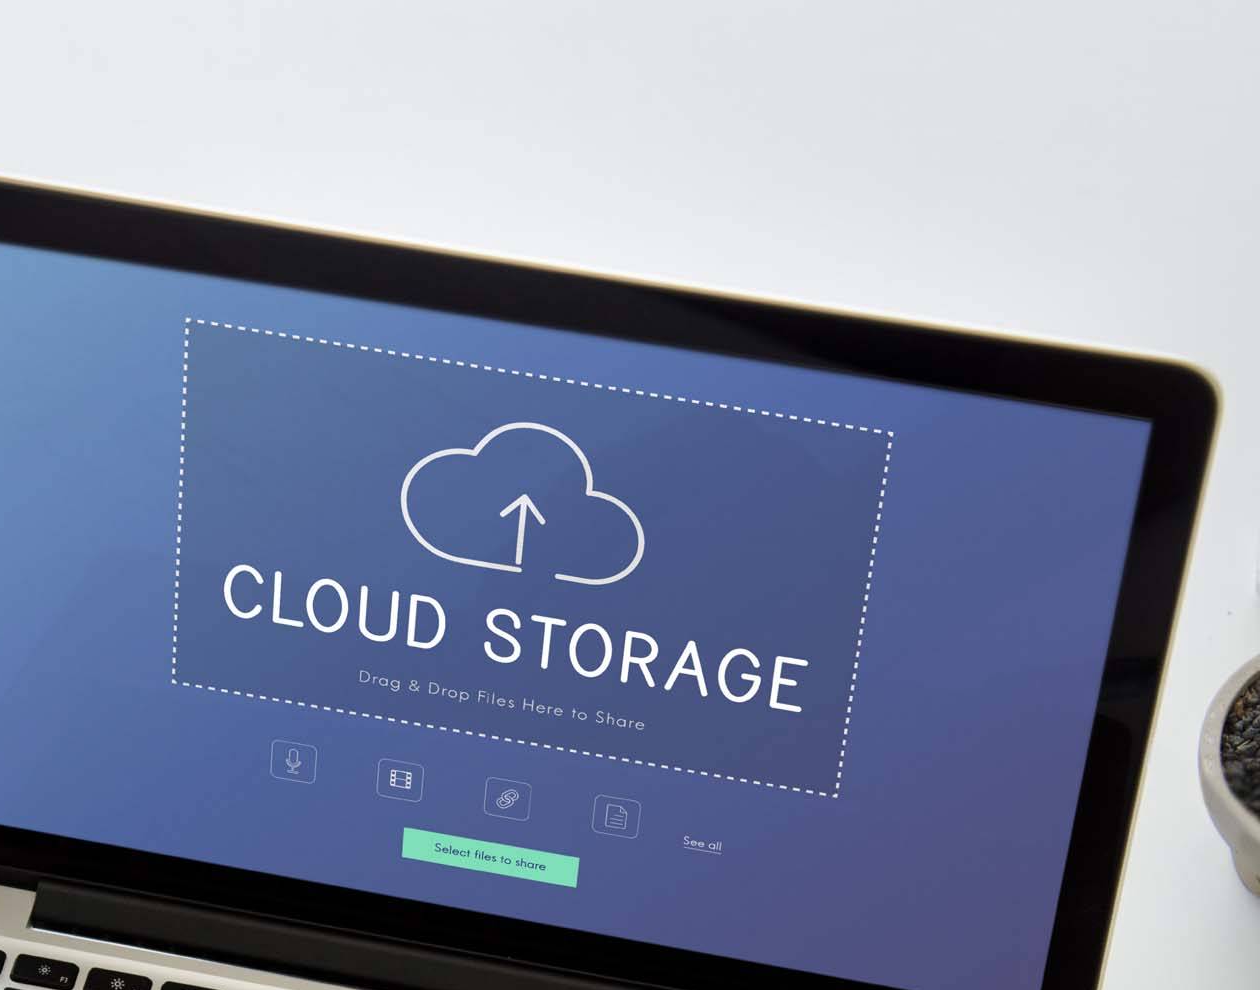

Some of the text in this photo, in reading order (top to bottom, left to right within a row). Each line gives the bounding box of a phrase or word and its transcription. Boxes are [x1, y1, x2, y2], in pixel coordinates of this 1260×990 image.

[224, 565, 808, 712] CLOUD STORAGE
[359, 670, 644, 730] Drag & Drop Files Here to Share
[434, 843, 546, 871] Select files to share
[684, 835, 722, 851] See all
